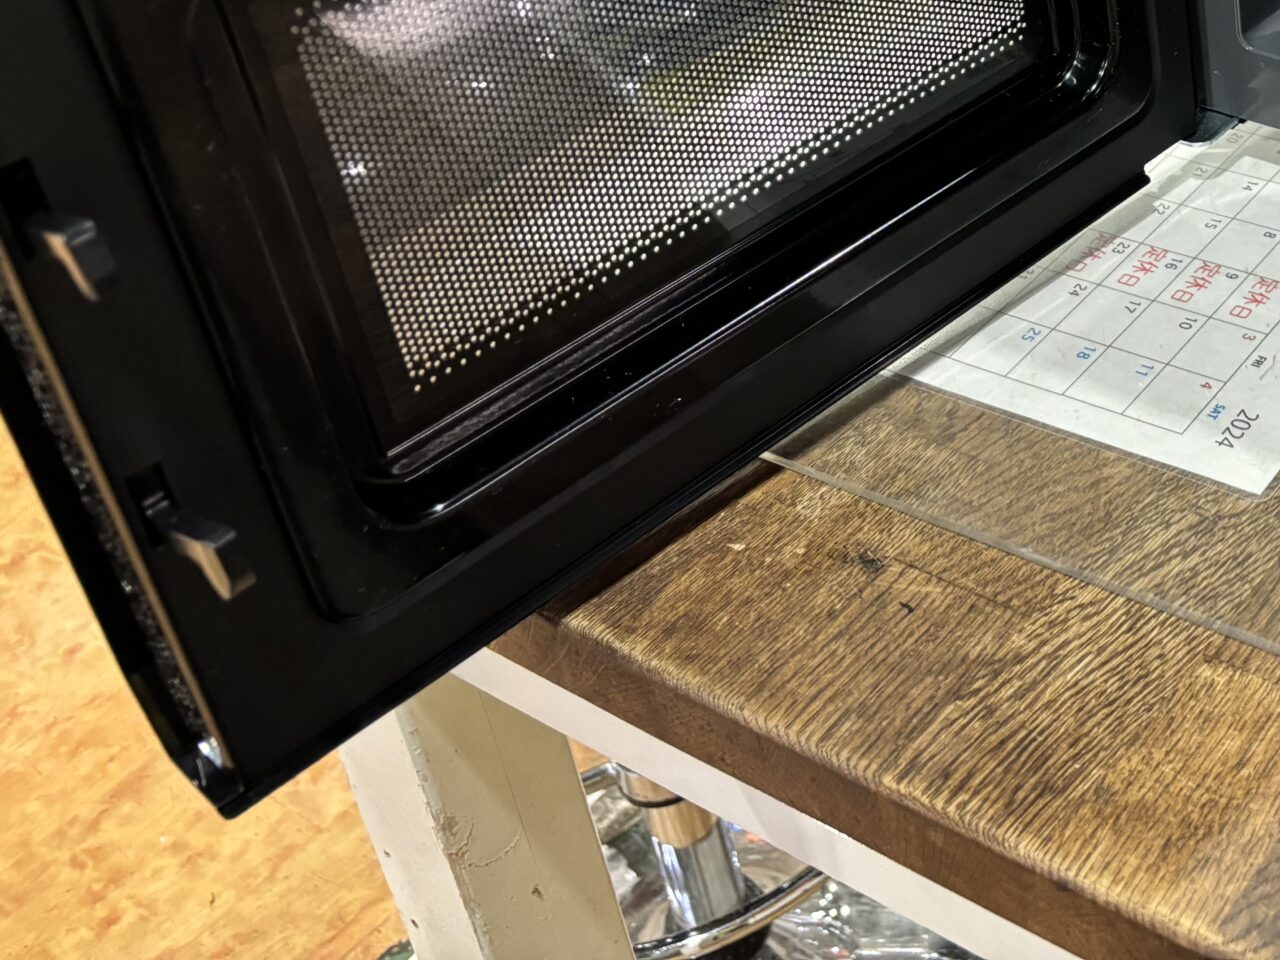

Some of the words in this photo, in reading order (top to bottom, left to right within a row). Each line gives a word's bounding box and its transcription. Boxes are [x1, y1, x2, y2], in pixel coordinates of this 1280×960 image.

[1060, 232, 1122, 274] 定休日
[1113, 245, 1174, 289] 定休日
[1167, 260, 1226, 305] 定休日
[1249, 354, 1267, 368] FRI
[1204, 403, 1226, 420] SAT
[1212, 408, 1261, 450] 2024
